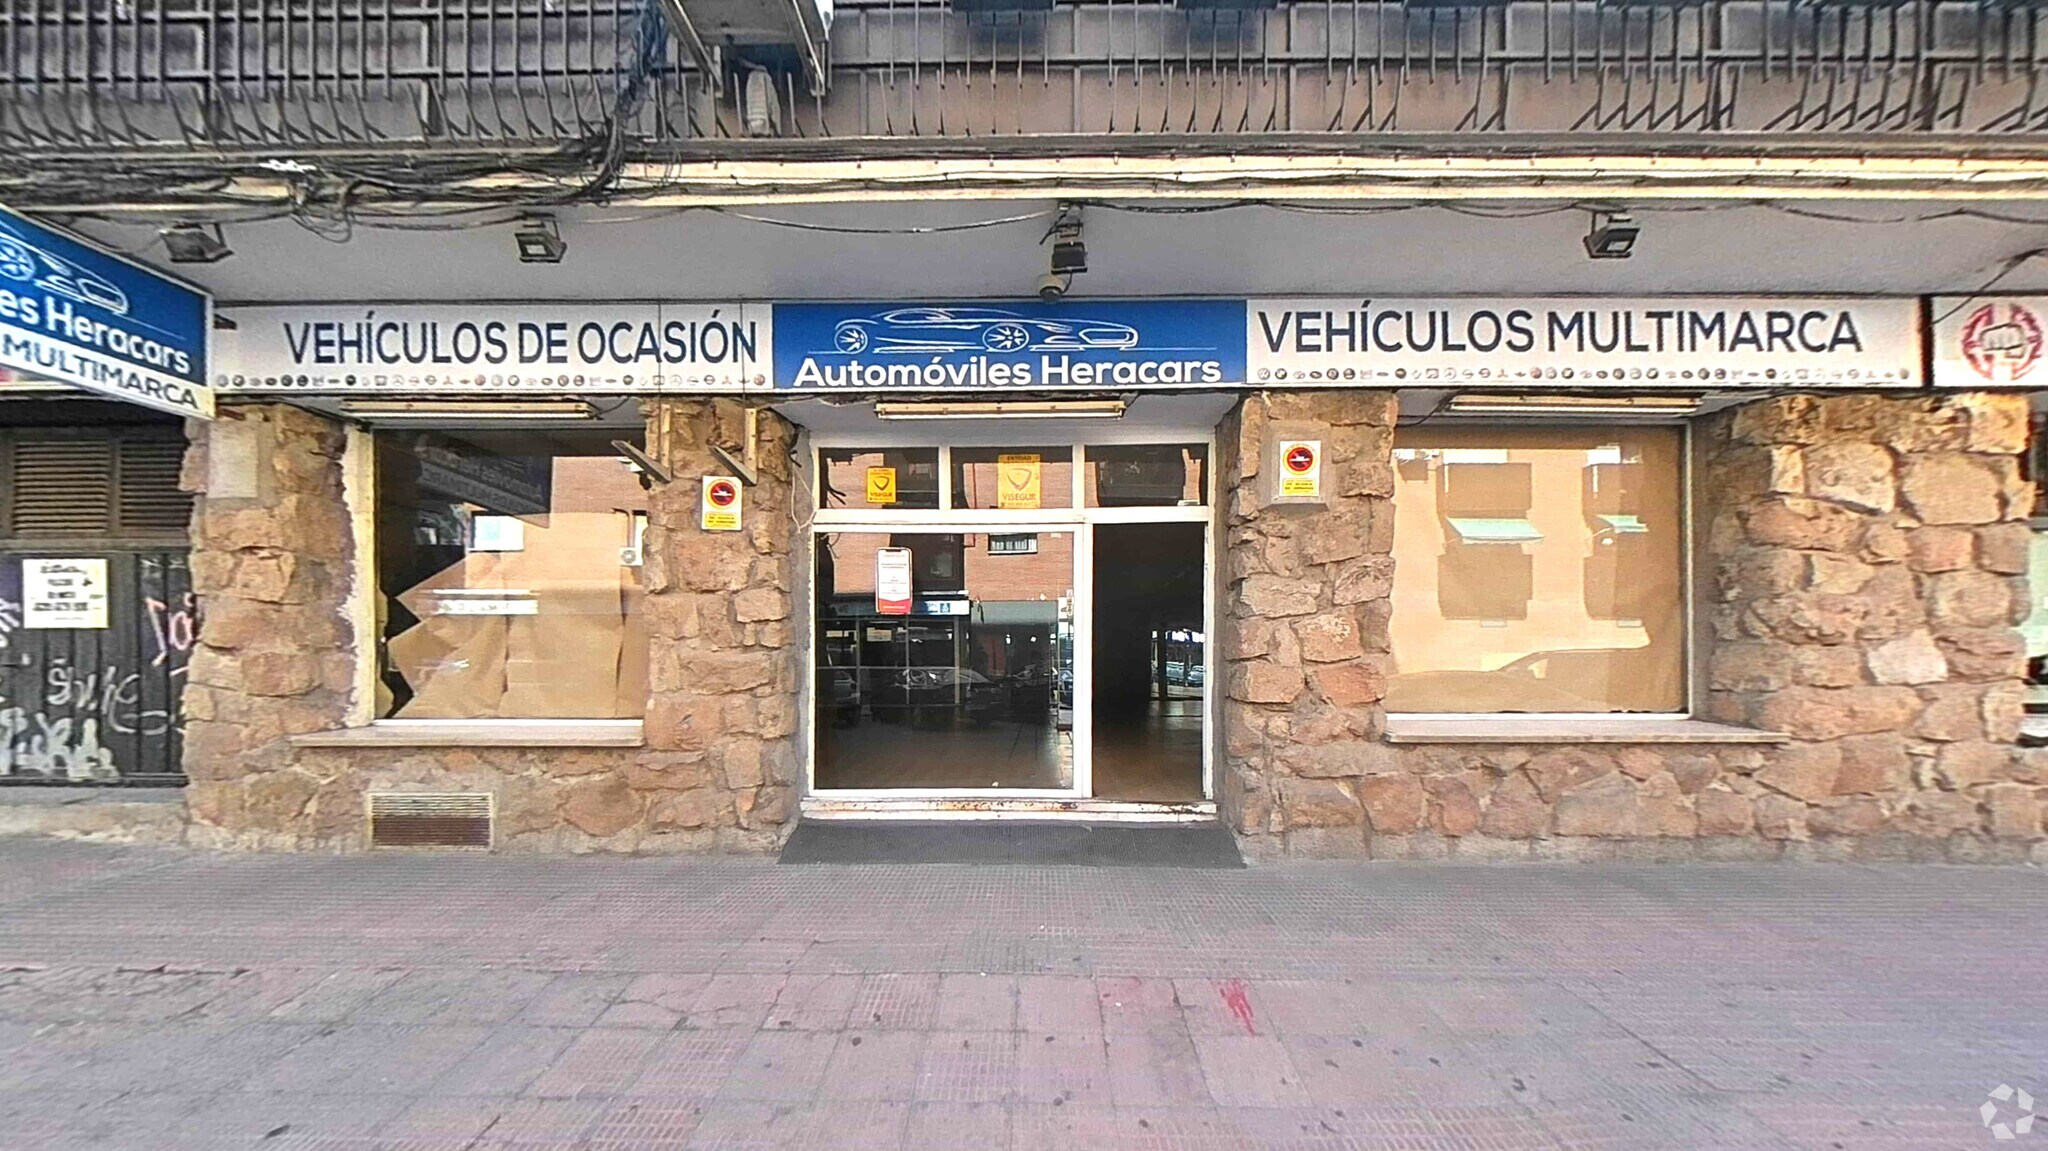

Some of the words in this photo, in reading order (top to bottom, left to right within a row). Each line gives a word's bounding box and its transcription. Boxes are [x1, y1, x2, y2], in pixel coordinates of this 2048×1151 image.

[45, 296, 191, 374] Heracars
[283, 311, 508, 364] VEHÍCULOS
[518, 322, 568, 364] DE
[577, 310, 756, 364] OCASIÓN
[1257, 300, 1534, 352] VEHÍCULOS
[1547, 310, 1863, 353] MULTIMARCA
[2, 333, 199, 409] MULTIMARCA
[793, 355, 1032, 387] Automóviles
[1041, 355, 1222, 385] Heracars
